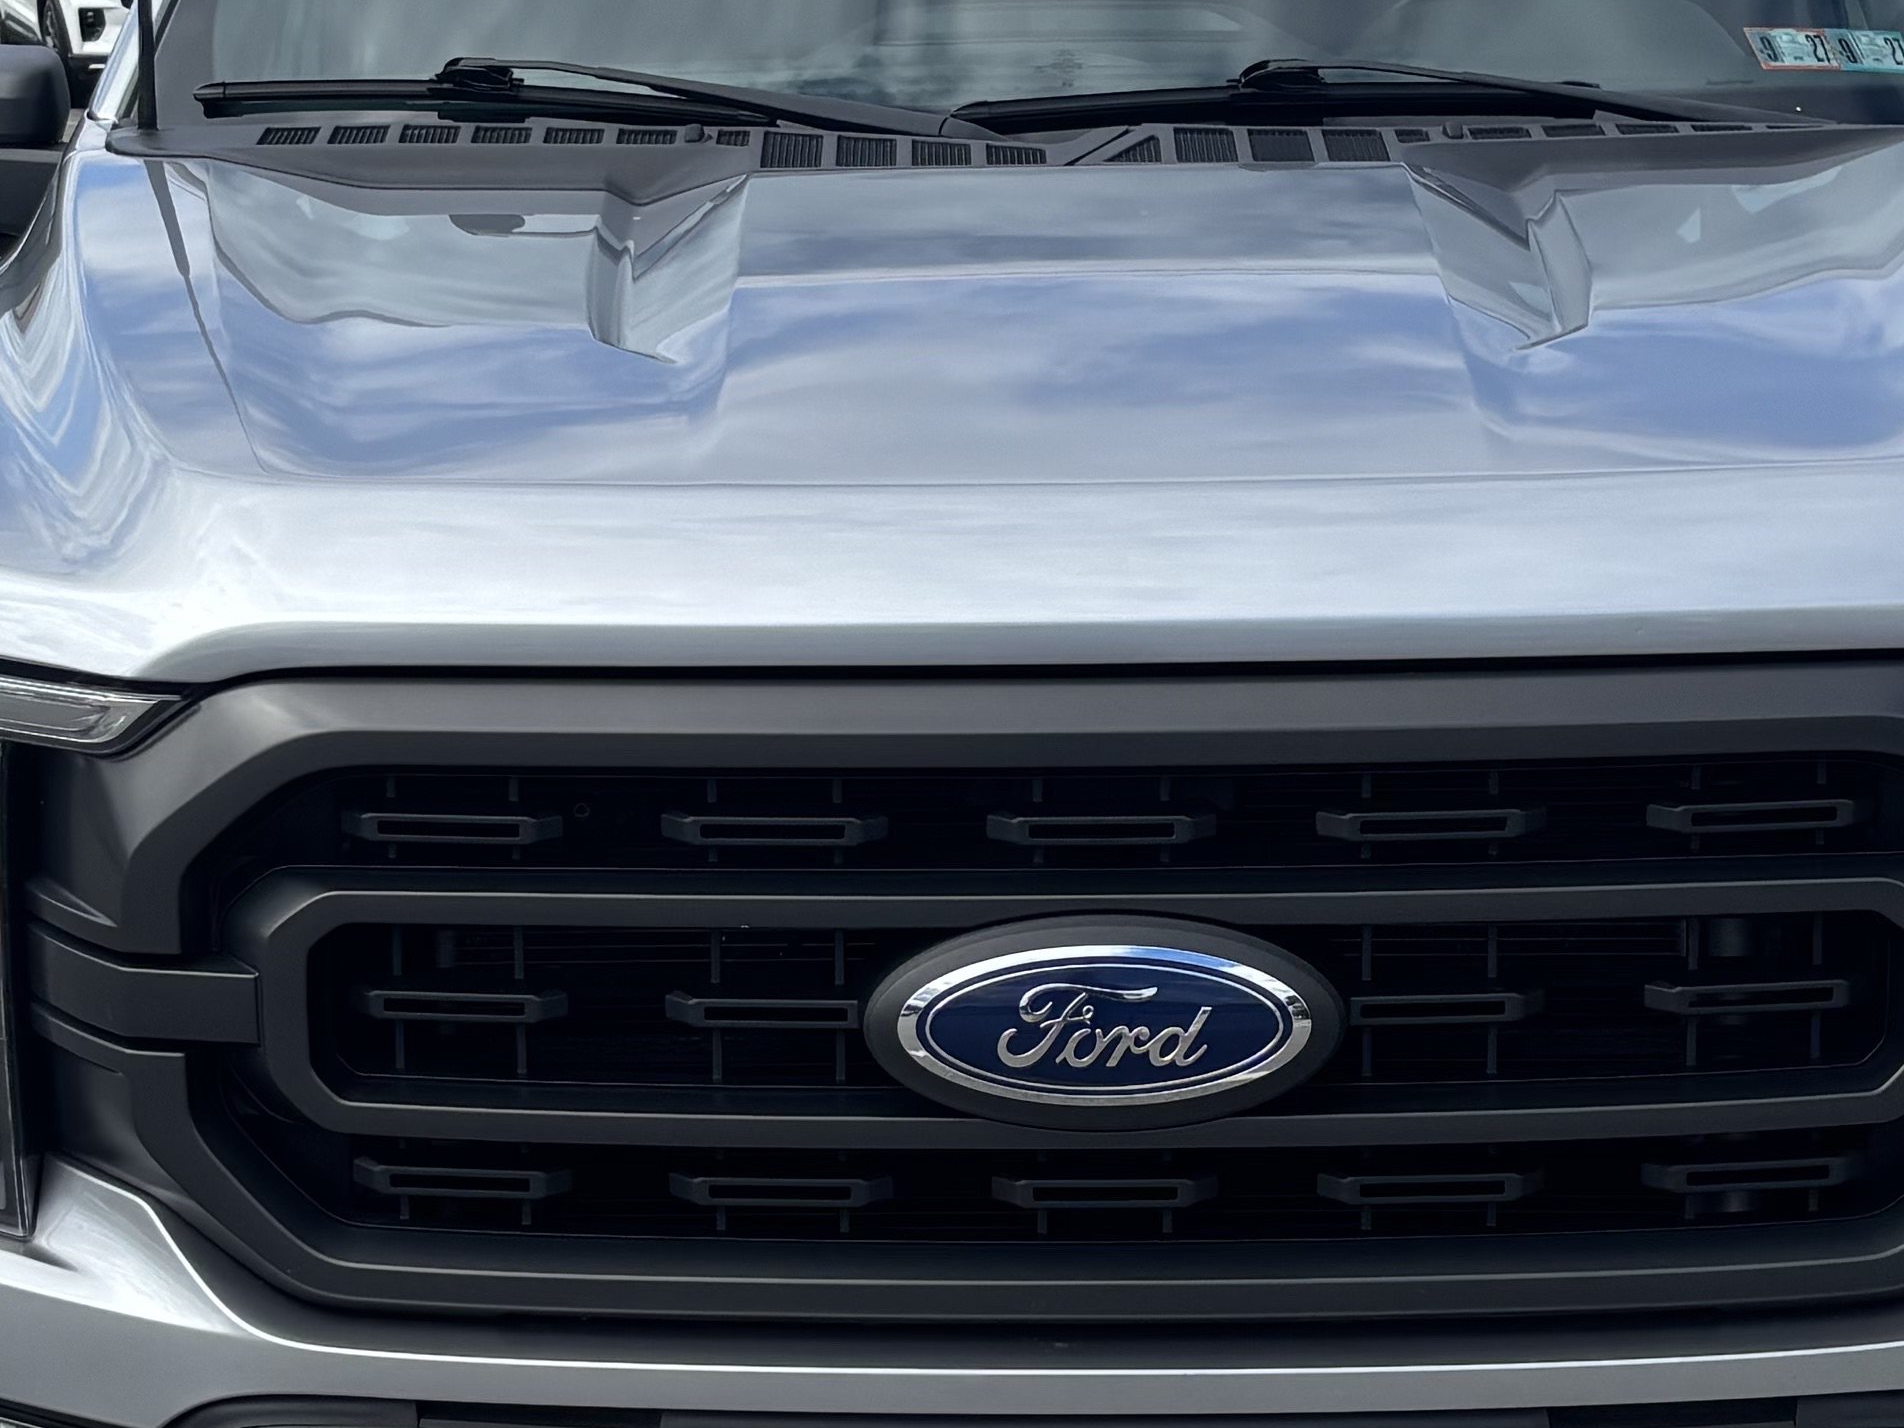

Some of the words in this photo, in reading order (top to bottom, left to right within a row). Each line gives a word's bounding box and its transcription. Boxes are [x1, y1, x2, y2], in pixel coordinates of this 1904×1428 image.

[1760, 36, 1779, 62] 9
[1804, 34, 1831, 64] 27
[1838, 38, 1858, 63] 9
[997, 982, 1213, 1068] Ford
